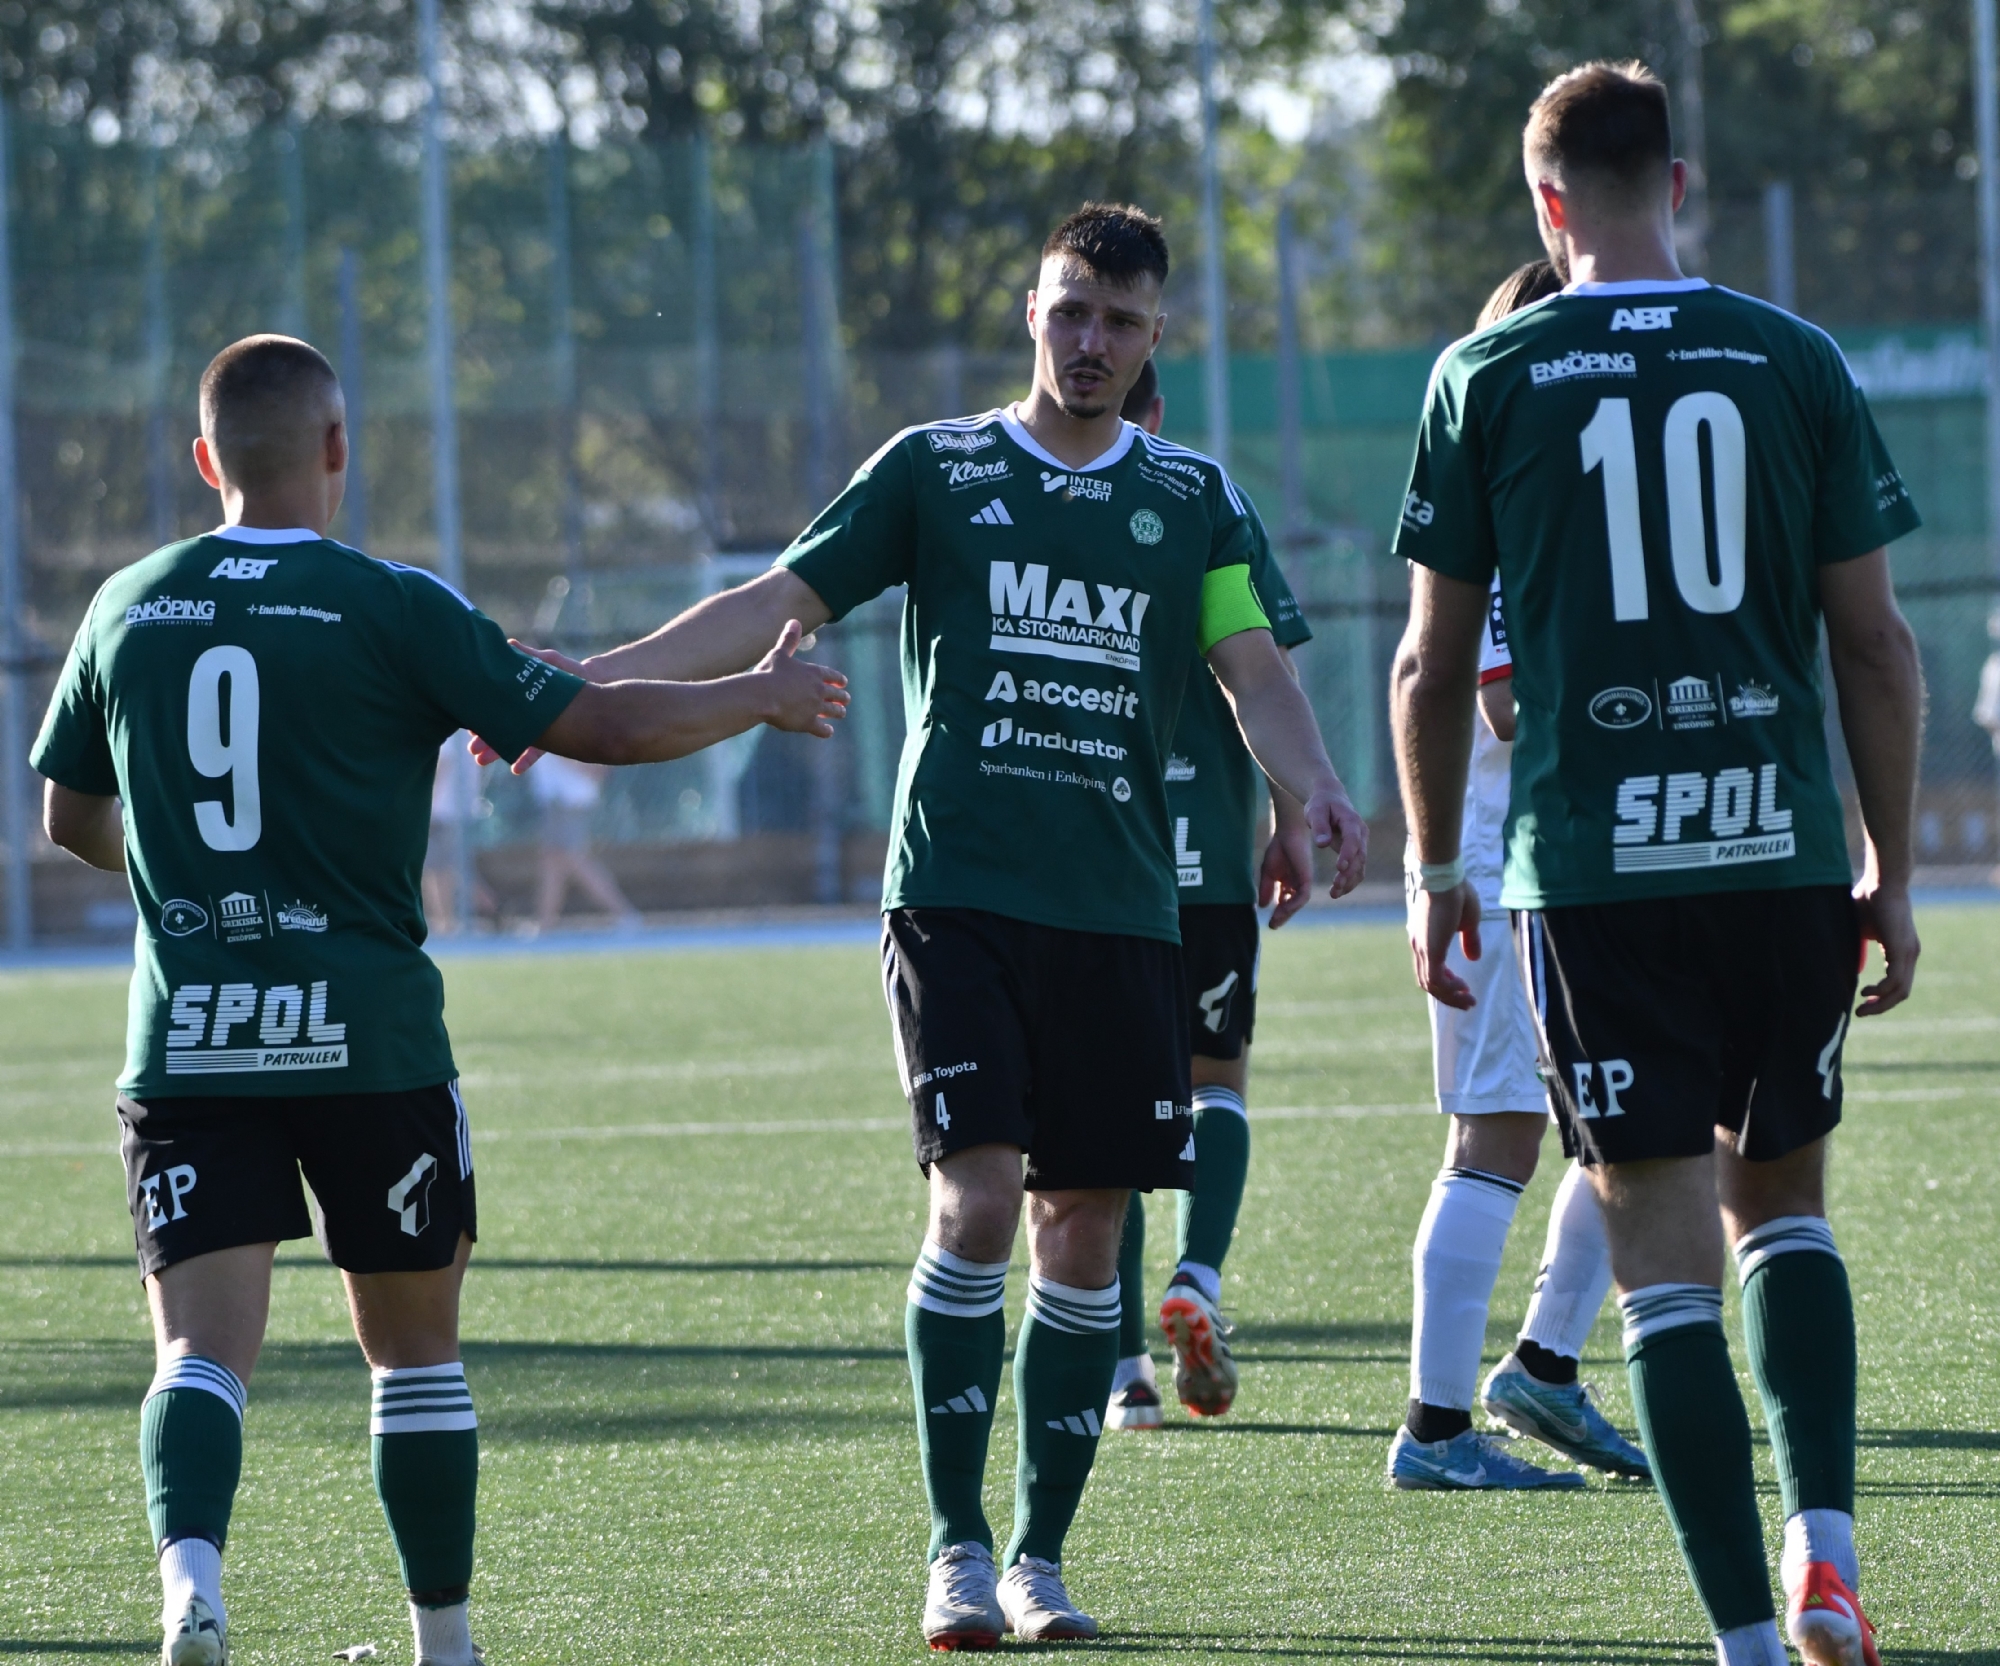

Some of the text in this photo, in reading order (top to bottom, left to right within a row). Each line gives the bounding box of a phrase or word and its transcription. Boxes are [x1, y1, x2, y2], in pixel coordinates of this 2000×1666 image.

[1610, 306, 1678, 331] ABT
[1530, 350, 1636, 384] ENKÖPING
[930, 432, 995, 453] Sibylla
[949, 460, 1009, 485] Klara
[1070, 474, 1113, 493] INTER
[1068, 485, 1112, 502] SPORT
[1189, 486, 1201, 496] AB
[1579, 390, 1746, 622] 10
[209, 557, 279, 580] ABT
[126, 595, 216, 622] ENKÖPING
[259, 605, 275, 615] Ena
[989, 560, 1150, 637] MAXI
[992, 616, 1141, 654] ICA STORMARKNAD
[1105, 653, 1139, 668] ENKÖPING
[1023, 679, 1139, 719] accesit
[1667, 701, 1718, 714] GREKISKA
[187, 644, 262, 852] 9
[1016, 727, 1128, 761] Industor
[979, 760, 1045, 781] Sparbanken
[1055, 770, 1107, 792] Enköping
[1613, 763, 1793, 844] SPOL
[1716, 838, 1791, 860] PATRULLEN
[221, 916, 264, 928] GREKISKA
[277, 911, 329, 927] Bredsand
[227, 933, 262, 943] ENKÖPING
[166, 980, 346, 1047] SPOL
[263, 1050, 342, 1067] PATRULLEN
[912, 1061, 978, 1089] Bilia Toyota
[1572, 1058, 1635, 1119] EP
[935, 1091, 951, 1131] 4
[139, 1163, 197, 1233] EP
